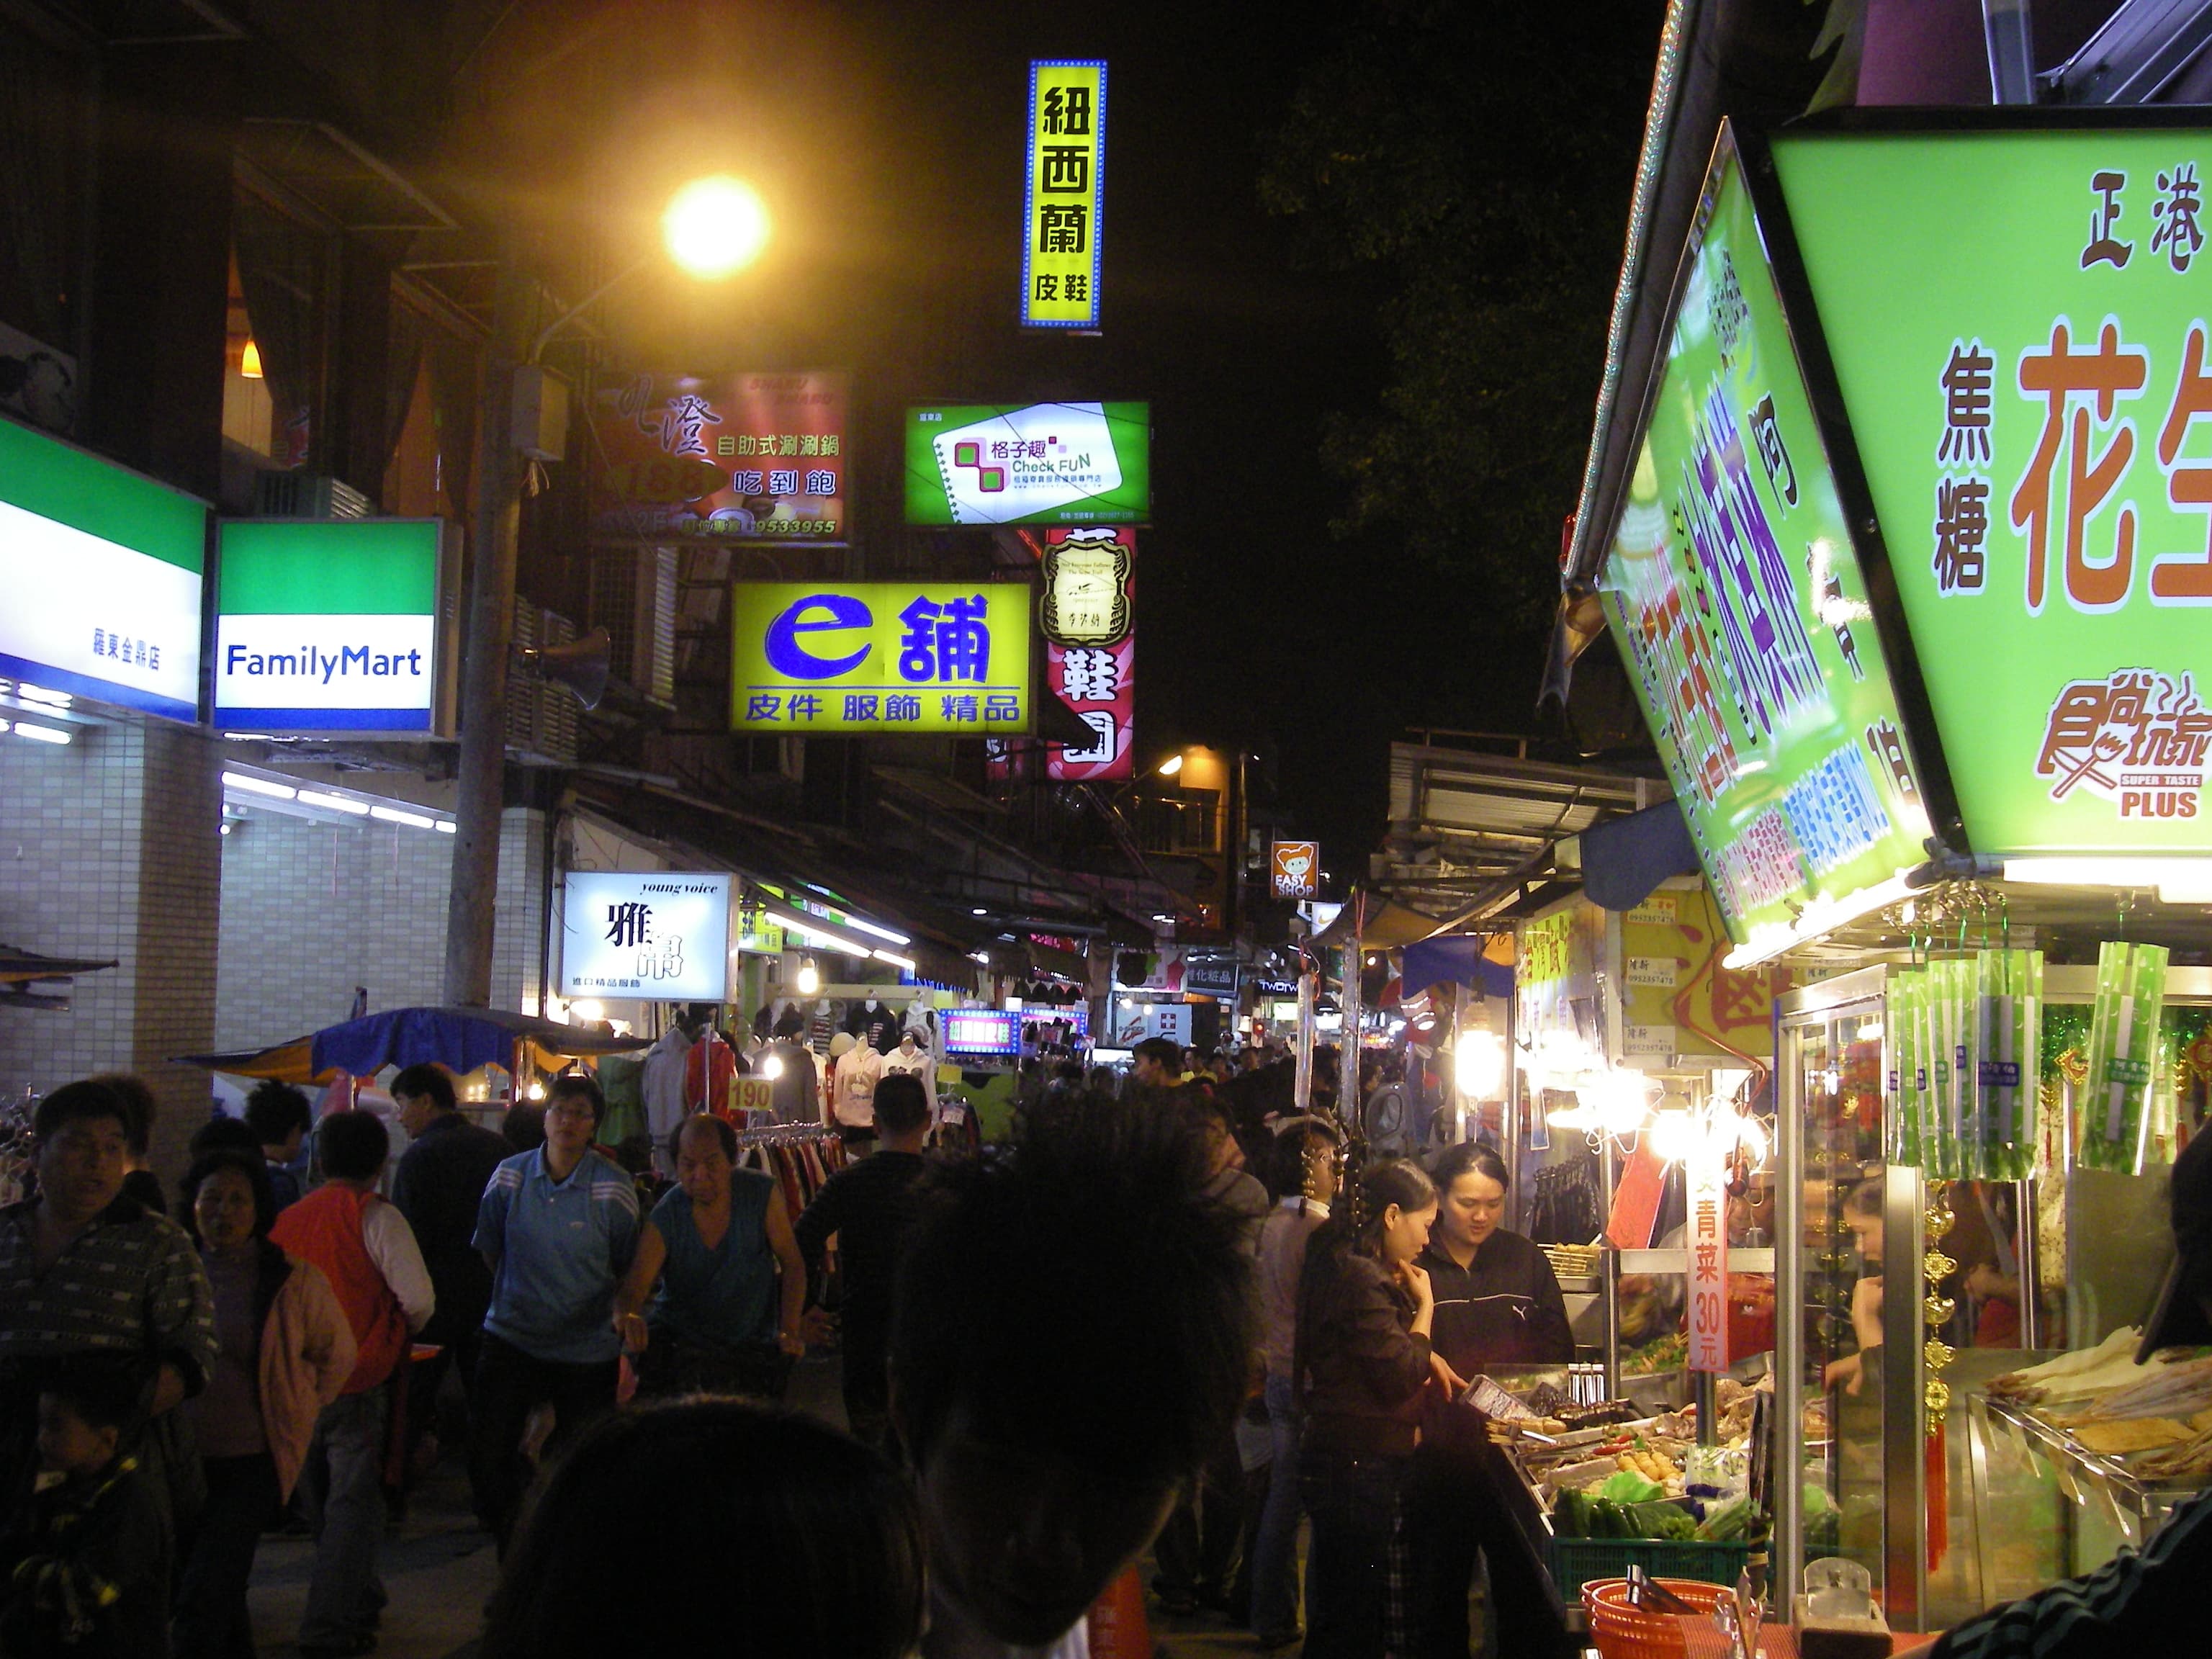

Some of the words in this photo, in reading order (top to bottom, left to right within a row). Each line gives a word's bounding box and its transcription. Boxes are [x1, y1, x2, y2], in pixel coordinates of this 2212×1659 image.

[1041, 86, 1091, 253] 紐西蘭
[2082, 164, 2204, 271] 正港
[1035, 274, 1088, 302] 皮鞋
[716, 434, 840, 457] 自助式涮涮鍋
[991, 441, 1047, 459] 格子趣
[1012, 460, 1055, 473] Check
[1059, 454, 1091, 473] FUN
[1933, 344, 1993, 592] 焦糖
[734, 470, 837, 495] 吃到飽
[93, 627, 161, 673] 羅東金鼎店
[226, 645, 422, 685] FamilyMart
[745, 694, 823, 721] 皮件
[842, 694, 922, 721] 服飾
[941, 694, 1021, 721] 精品
[2121, 775, 2160, 786] SUPER
[2164, 775, 2200, 786] TASTE
[2121, 792, 2197, 817] PLUS
[639, 883, 683, 895] young
[685, 885, 719, 894] voice
[1275, 874, 1307, 887] EASY
[1277, 884, 1314, 896] SHOP
[732, 1081, 770, 1107] 190
